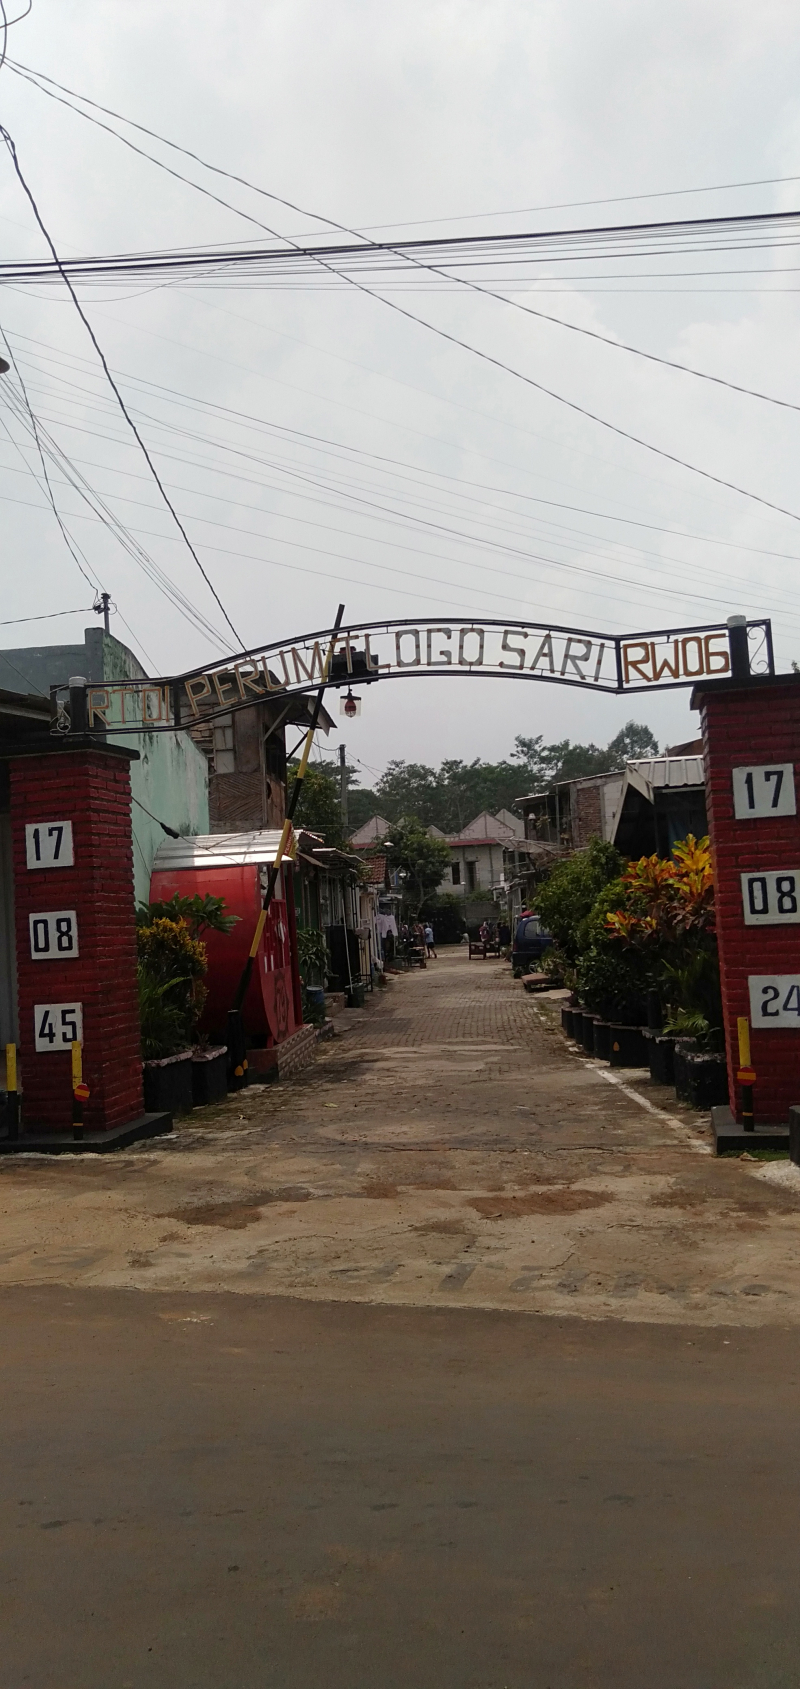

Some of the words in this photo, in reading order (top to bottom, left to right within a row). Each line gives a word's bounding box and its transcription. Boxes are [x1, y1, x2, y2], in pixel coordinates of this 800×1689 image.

[184, 641, 324, 717] PERUM
[331, 627, 485, 673] TLOGO
[499, 629, 606, 682] SARI
[622, 633, 731, 684] RW06
[745, 769, 784, 810] 17
[32, 826, 64, 861] 17
[748, 875, 799, 915] 08
[32, 917, 73, 953] 08
[761, 985, 800, 1018] 24
[38, 1009, 78, 1044] 45
